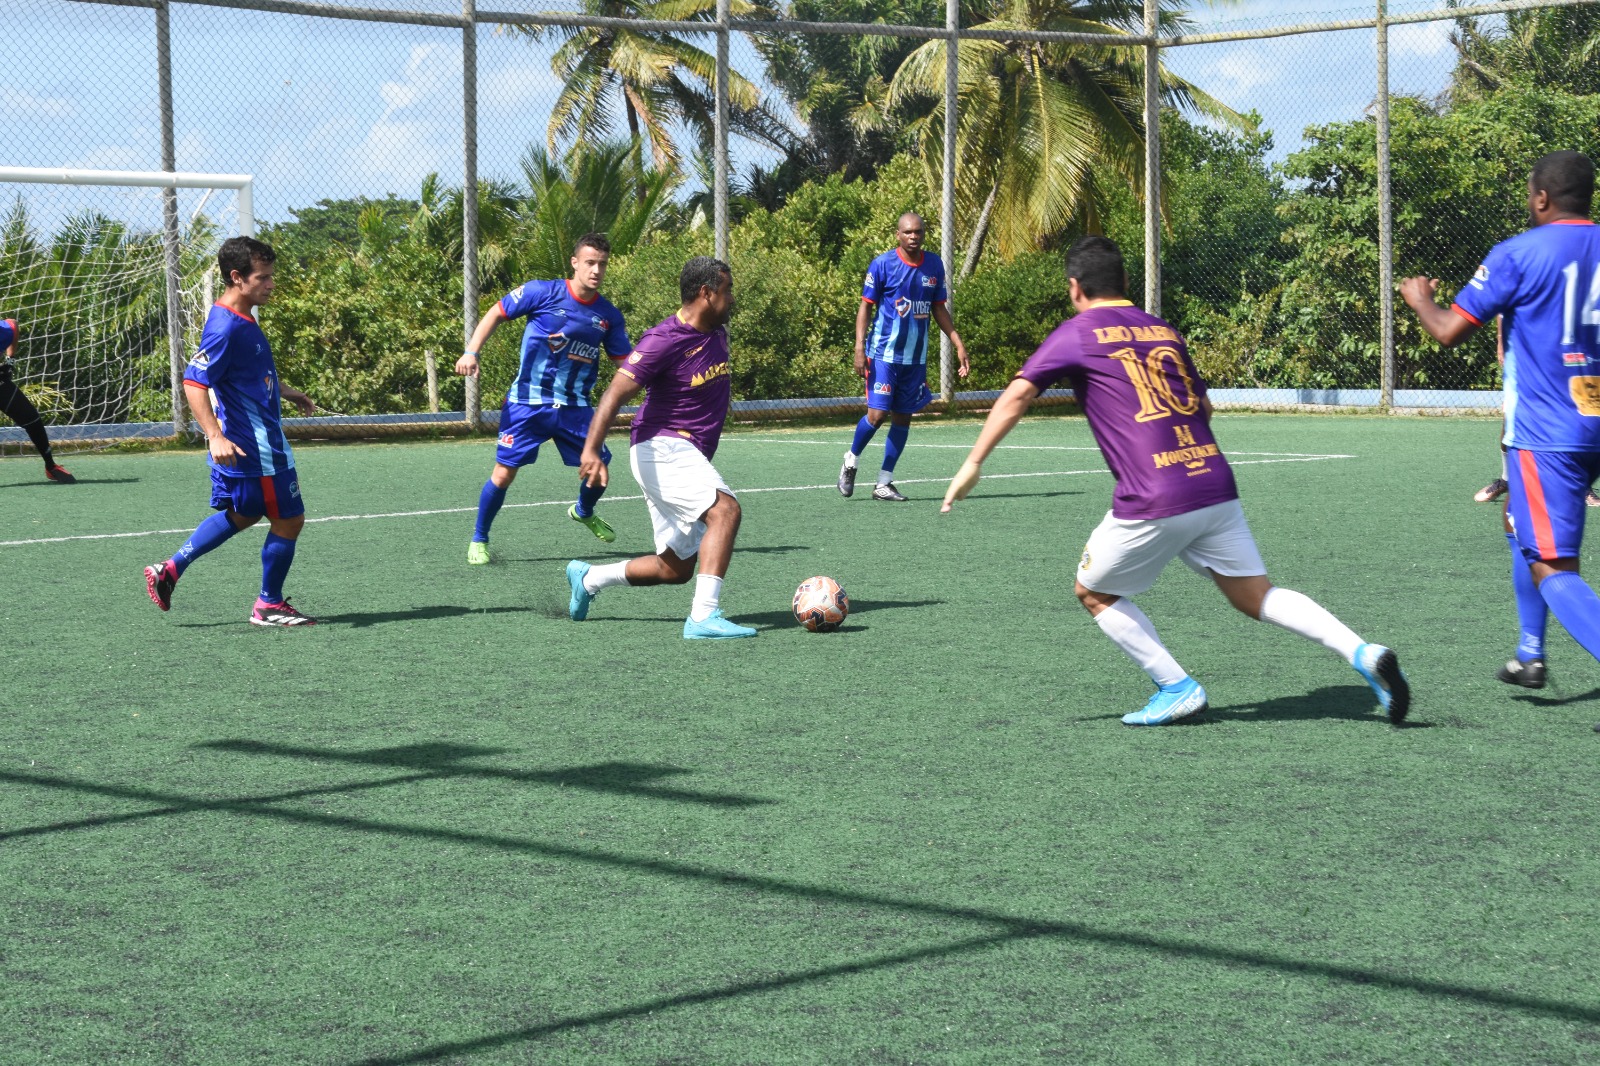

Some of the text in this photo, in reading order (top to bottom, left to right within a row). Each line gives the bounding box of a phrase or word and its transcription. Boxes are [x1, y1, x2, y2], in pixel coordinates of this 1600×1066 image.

[1092, 326, 1133, 344] LEO
[1107, 346, 1199, 422] 10
[1172, 424, 1197, 447] M
